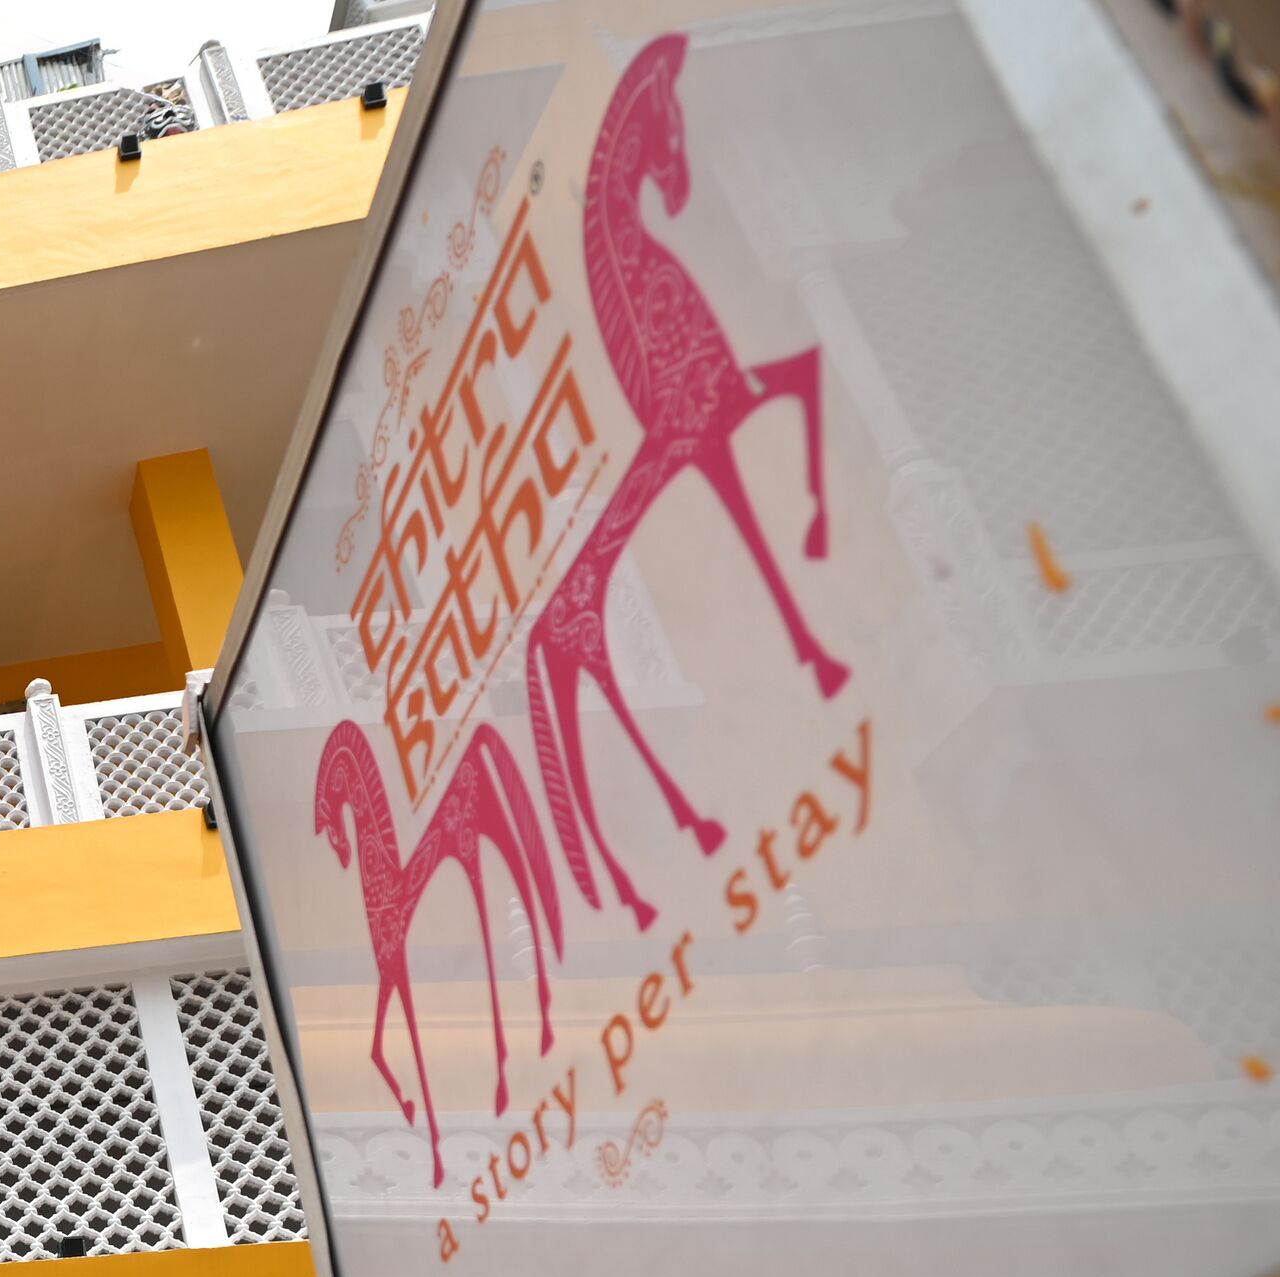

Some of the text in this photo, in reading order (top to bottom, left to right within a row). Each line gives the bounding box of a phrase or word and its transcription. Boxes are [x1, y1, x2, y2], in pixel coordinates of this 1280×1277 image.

[435, 716, 873, 1263] a story per stay
